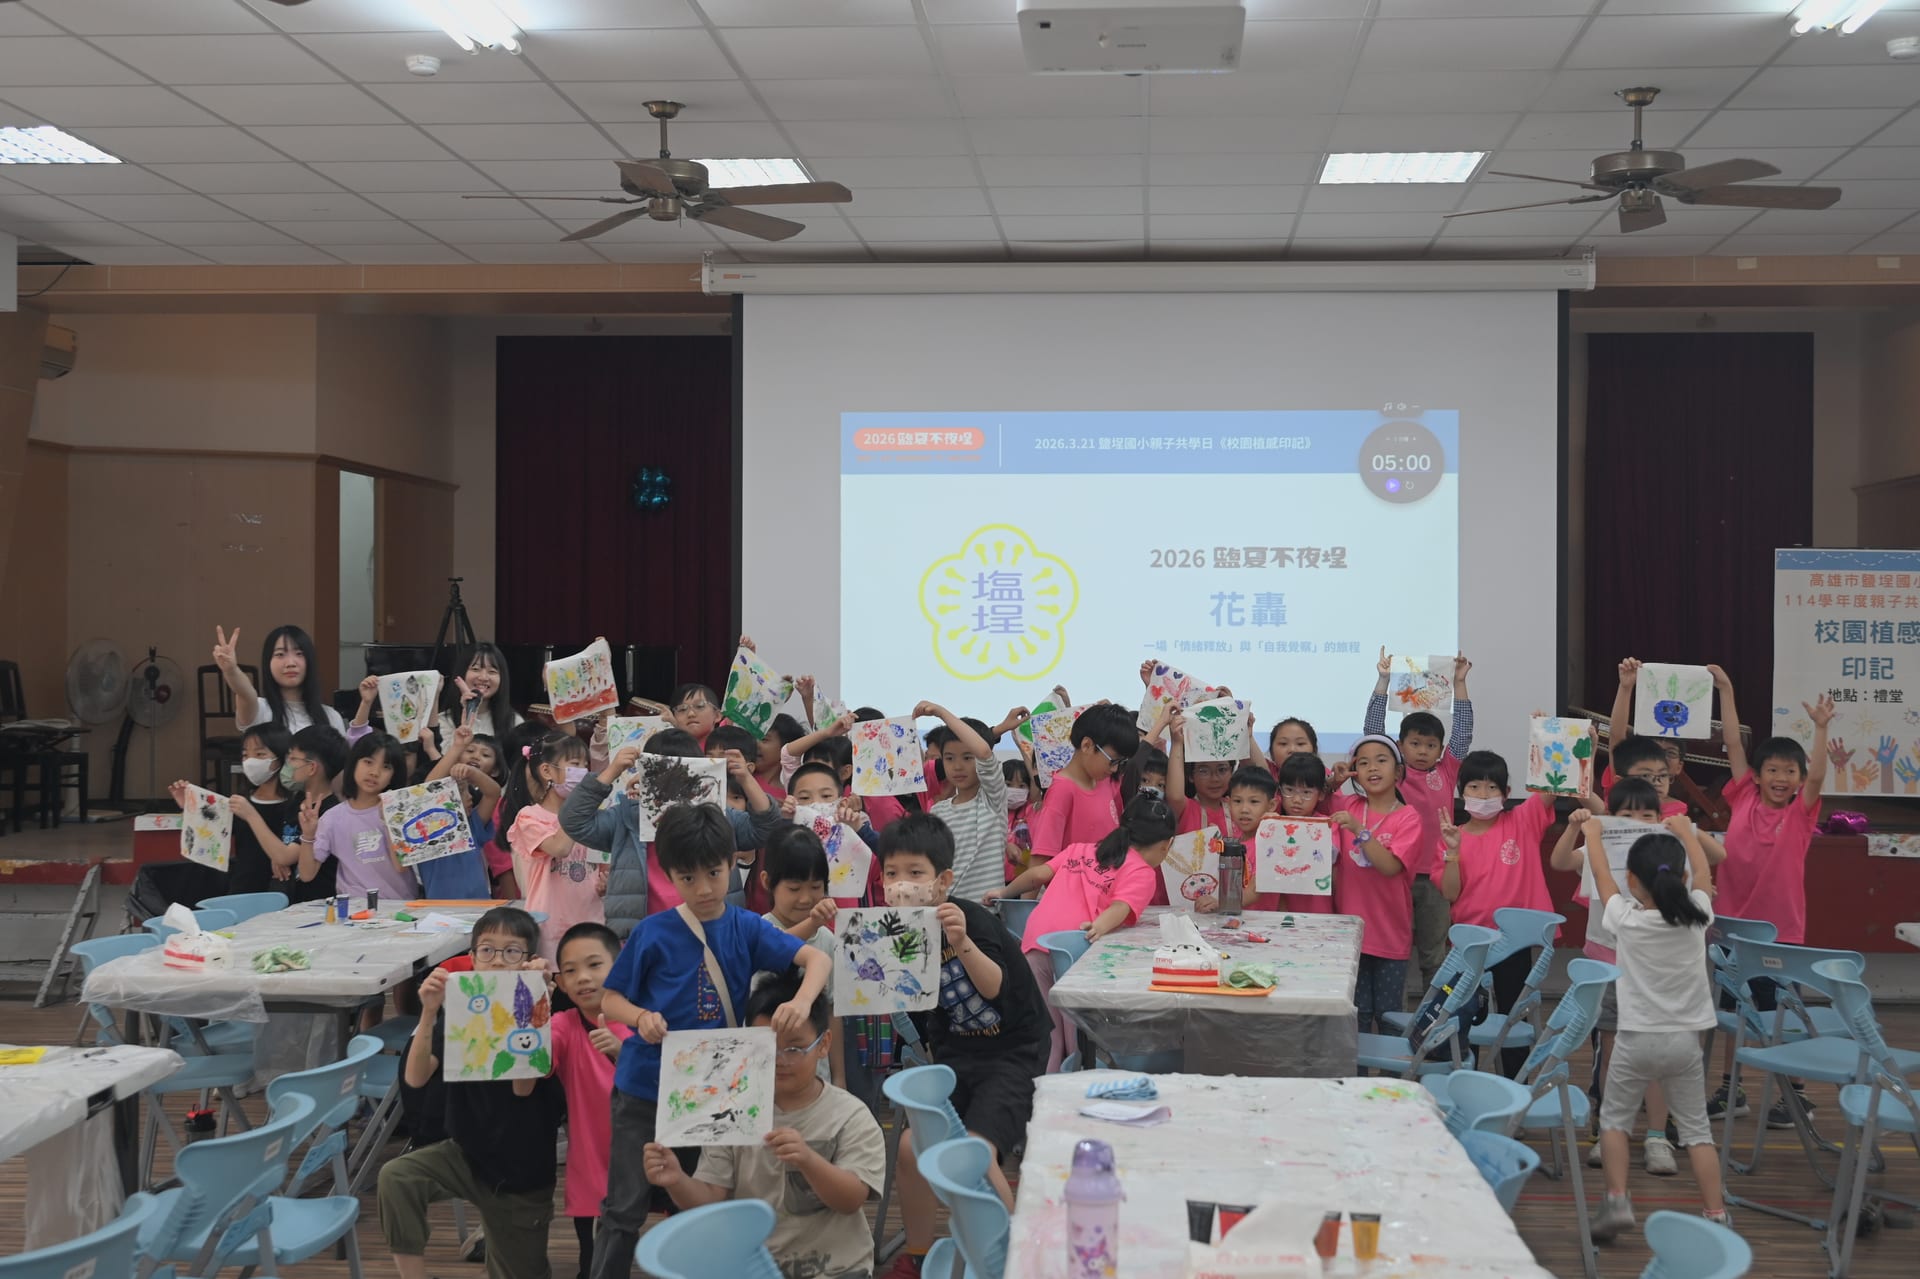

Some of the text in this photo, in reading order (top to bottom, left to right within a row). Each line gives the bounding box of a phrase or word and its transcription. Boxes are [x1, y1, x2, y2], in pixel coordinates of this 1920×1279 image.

[1034, 437, 1096, 449] 2026.3.21
[1372, 454, 1431, 471] 05:00
[1150, 549, 1206, 568] 2026
[1209, 591, 1288, 627] 花轟
[1785, 594, 1920, 608] 114學年度親子共
[1814, 619, 1920, 645] 校園植感
[1841, 656, 1895, 681] 印記
[1828, 688, 1903, 703] 地點：禮堂
